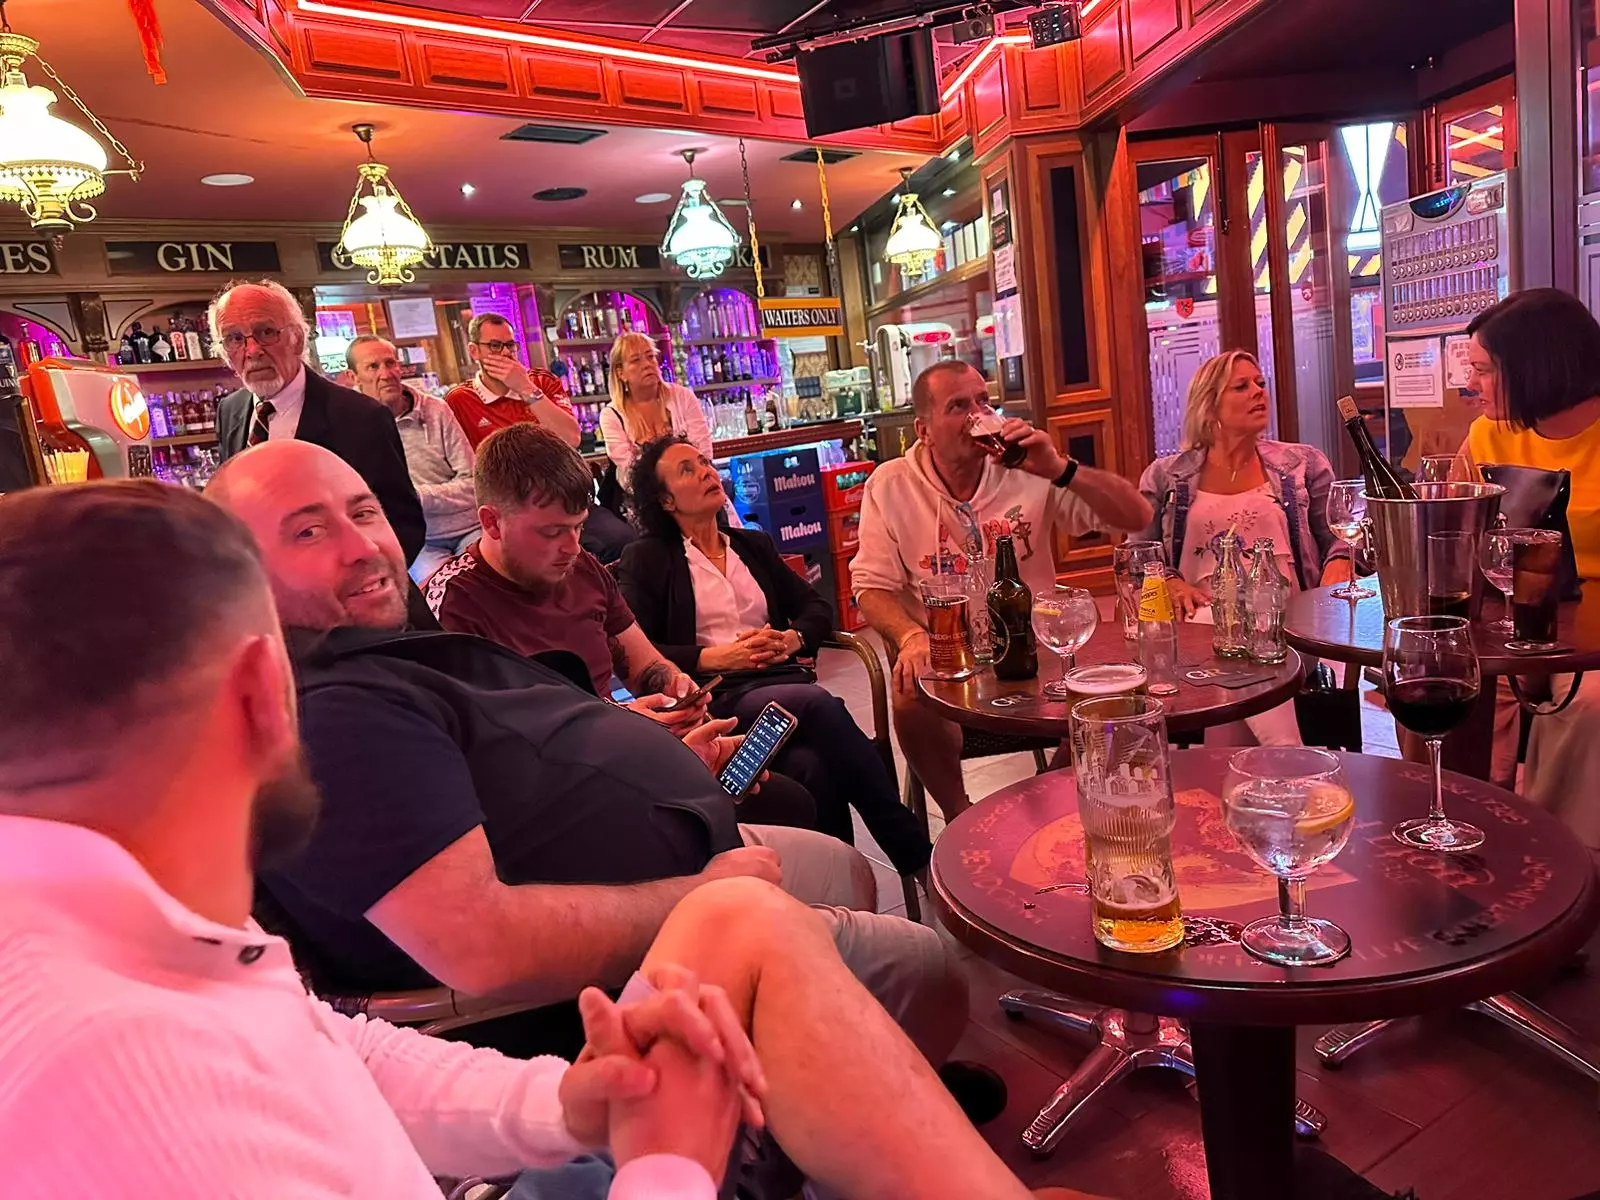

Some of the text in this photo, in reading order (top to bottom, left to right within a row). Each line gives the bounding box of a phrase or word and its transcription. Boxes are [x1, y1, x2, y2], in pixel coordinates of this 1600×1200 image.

[0, 243, 51, 273] ES
[157, 243, 234, 272] GIN
[331, 244, 520, 270] CTAILS
[582, 246, 639, 268] RUM
[764, 308, 836, 326] WAITERS ONLY
[773, 473, 816, 492] Mahou
[780, 521, 822, 541] Mahou
